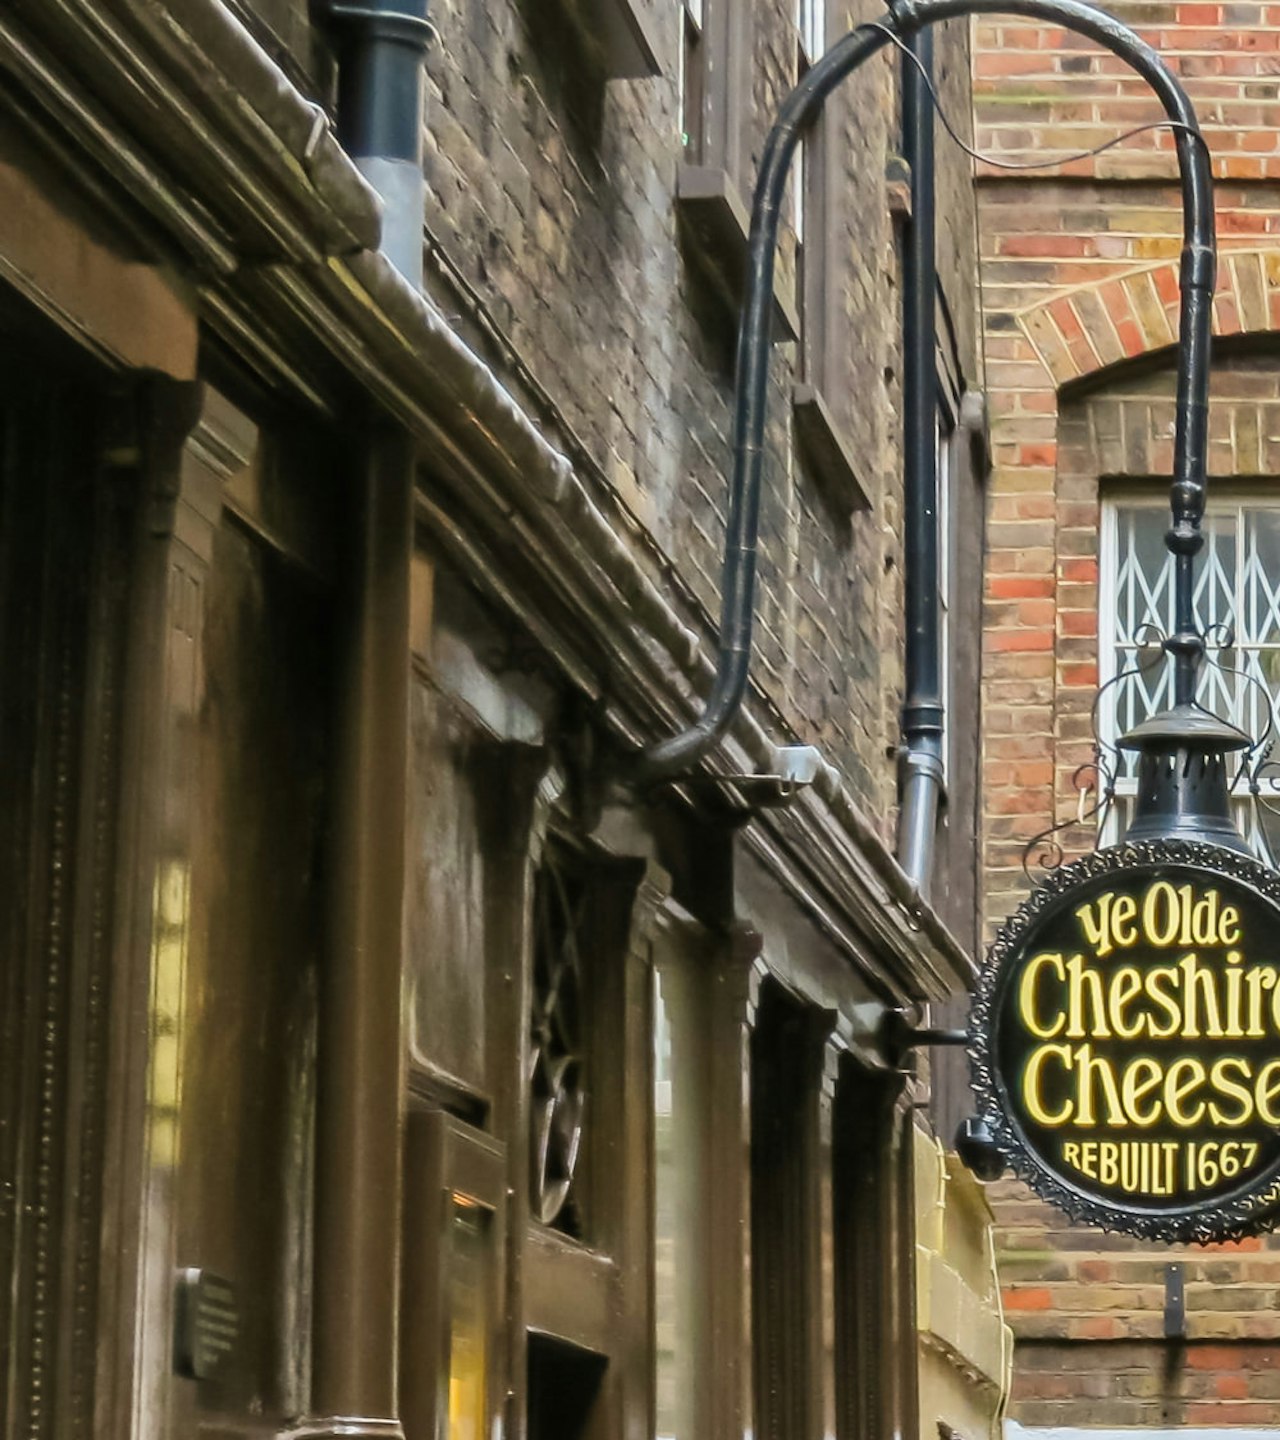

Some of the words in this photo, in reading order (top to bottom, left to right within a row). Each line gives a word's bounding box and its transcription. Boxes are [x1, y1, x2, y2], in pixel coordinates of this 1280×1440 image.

[1142, 881, 1241, 945] Olde
[1063, 1141, 1179, 1195] REBUILT
[1187, 1141, 1258, 1191] 1667
